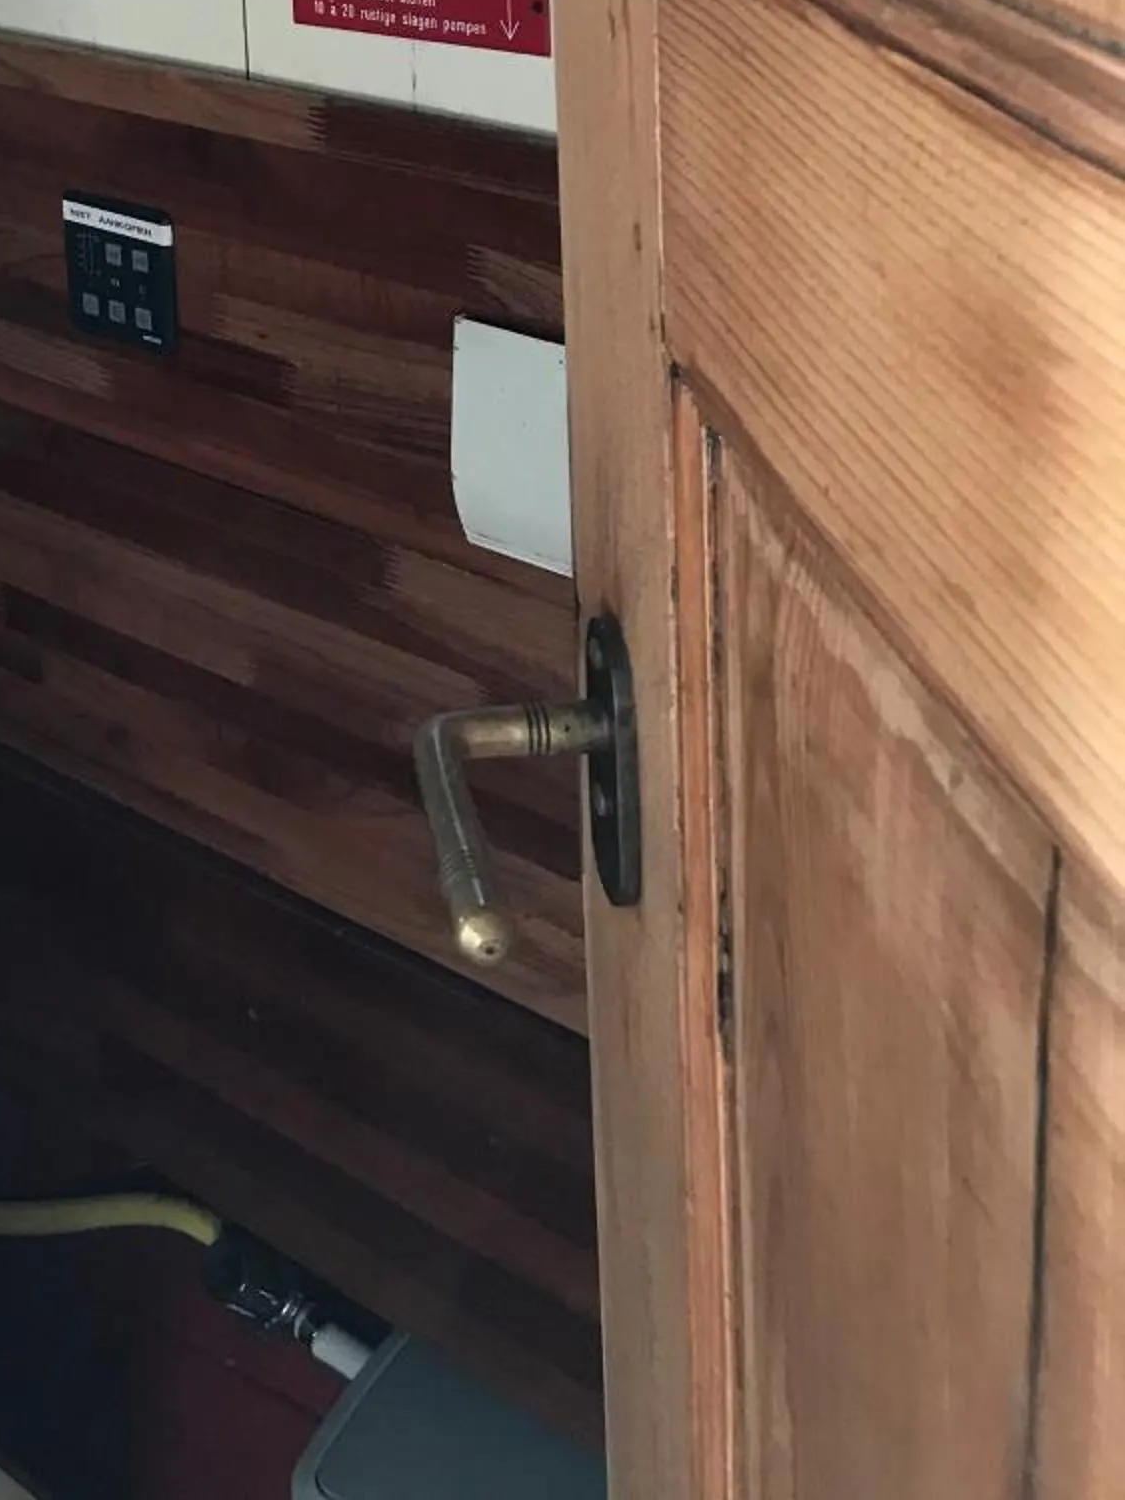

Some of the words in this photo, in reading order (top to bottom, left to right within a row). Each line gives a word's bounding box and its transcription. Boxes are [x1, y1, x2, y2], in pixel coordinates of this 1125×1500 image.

[314, 0, 325, 15] 10
[342, 3, 354, 19] 20
[360, 7, 396, 27] rustige
[402, 12, 438, 32] slagen
[442, 19, 487, 36] pompen
